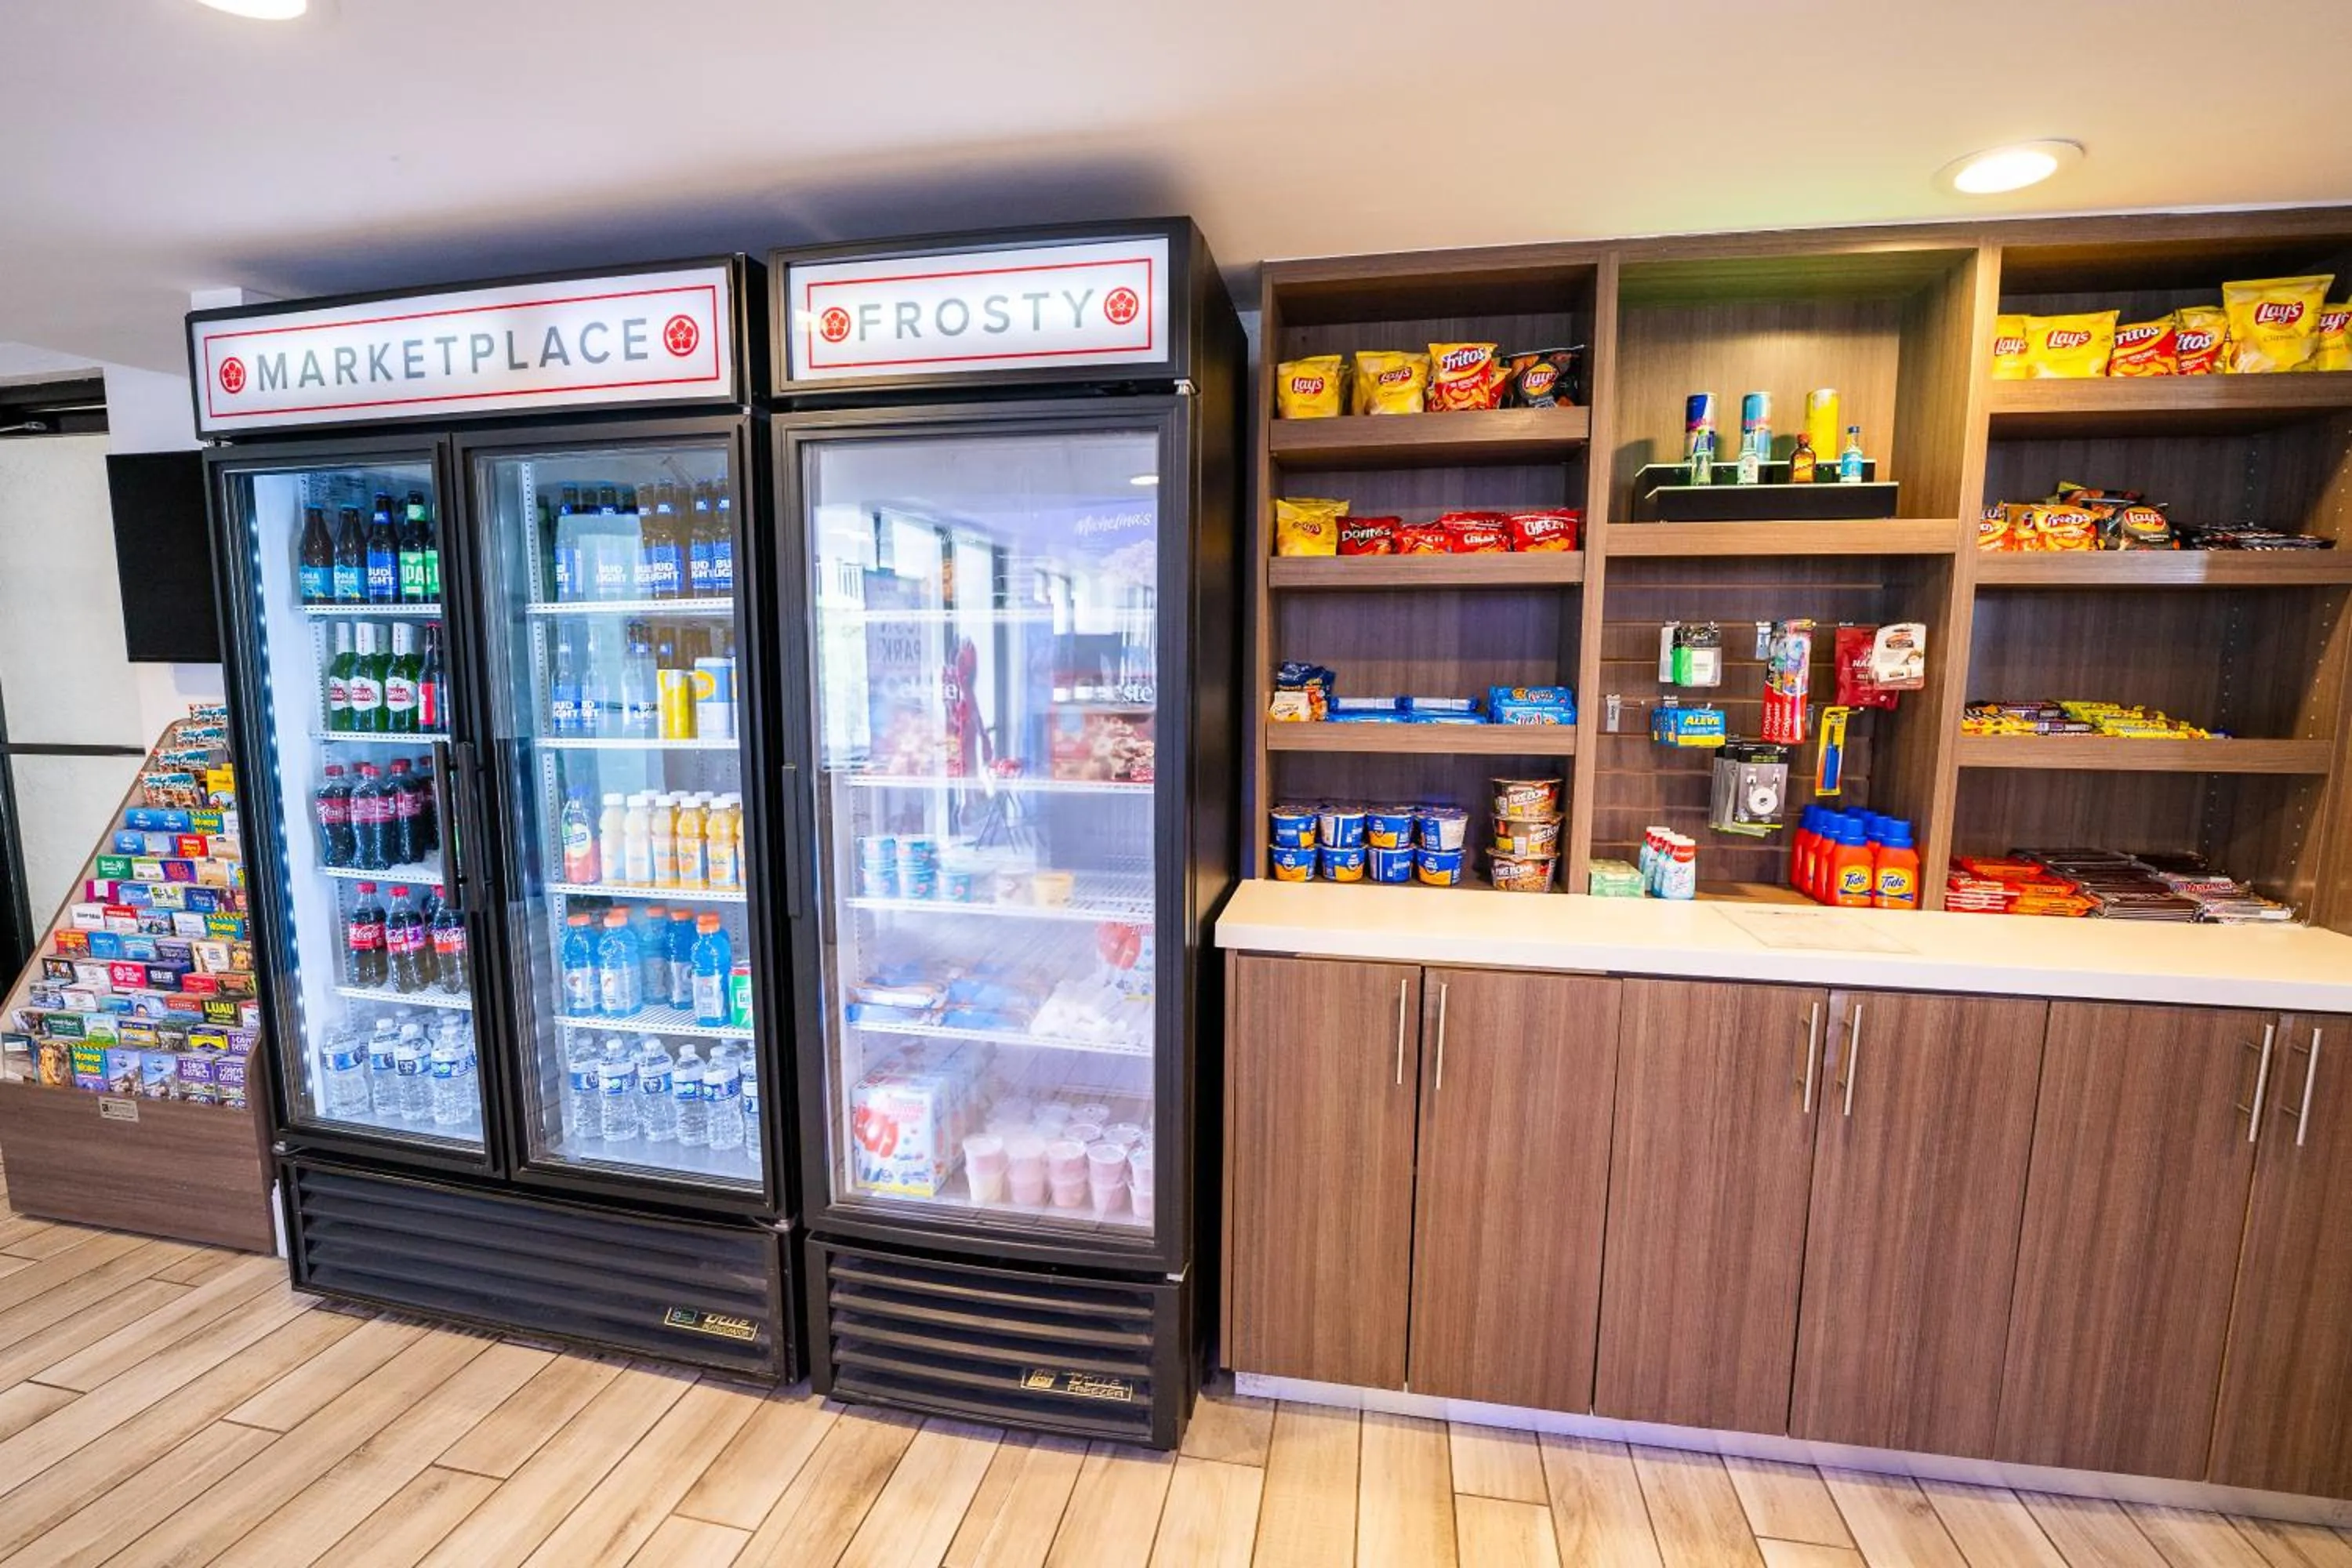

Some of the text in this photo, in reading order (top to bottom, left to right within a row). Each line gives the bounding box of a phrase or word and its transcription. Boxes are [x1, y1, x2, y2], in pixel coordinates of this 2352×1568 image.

[858, 289, 1094, 341] FROSTY
[2258, 303, 2302, 325] Lay's
[2048, 331, 2090, 348] Lay's
[256, 318, 649, 391] MARKETPLACE
[1294, 378, 1324, 394] Lay's
[1341, 528, 1392, 542] Doritos
[1684, 715, 1720, 725] ALEVE
[1845, 873, 1866, 888] Tide
[1882, 876, 1905, 889] Tide
[205, 1002, 234, 1014] LUAU
